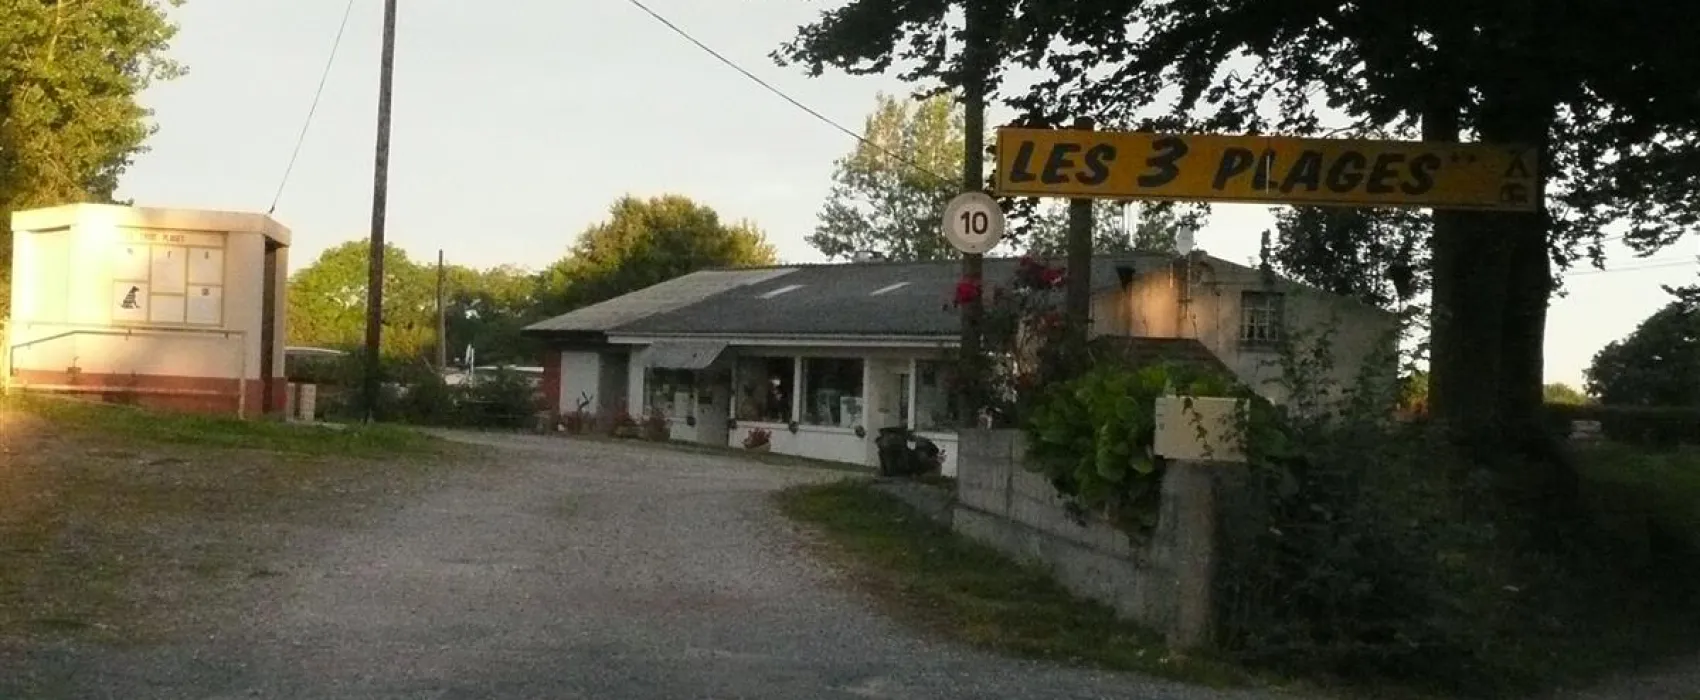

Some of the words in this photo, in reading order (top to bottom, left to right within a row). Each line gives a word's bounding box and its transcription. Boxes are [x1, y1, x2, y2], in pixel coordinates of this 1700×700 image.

[1010, 141, 1116, 184] LES
[1137, 137, 1188, 187] 3
[1212, 147, 1441, 195] PLAGES
[961, 211, 988, 235] 10
